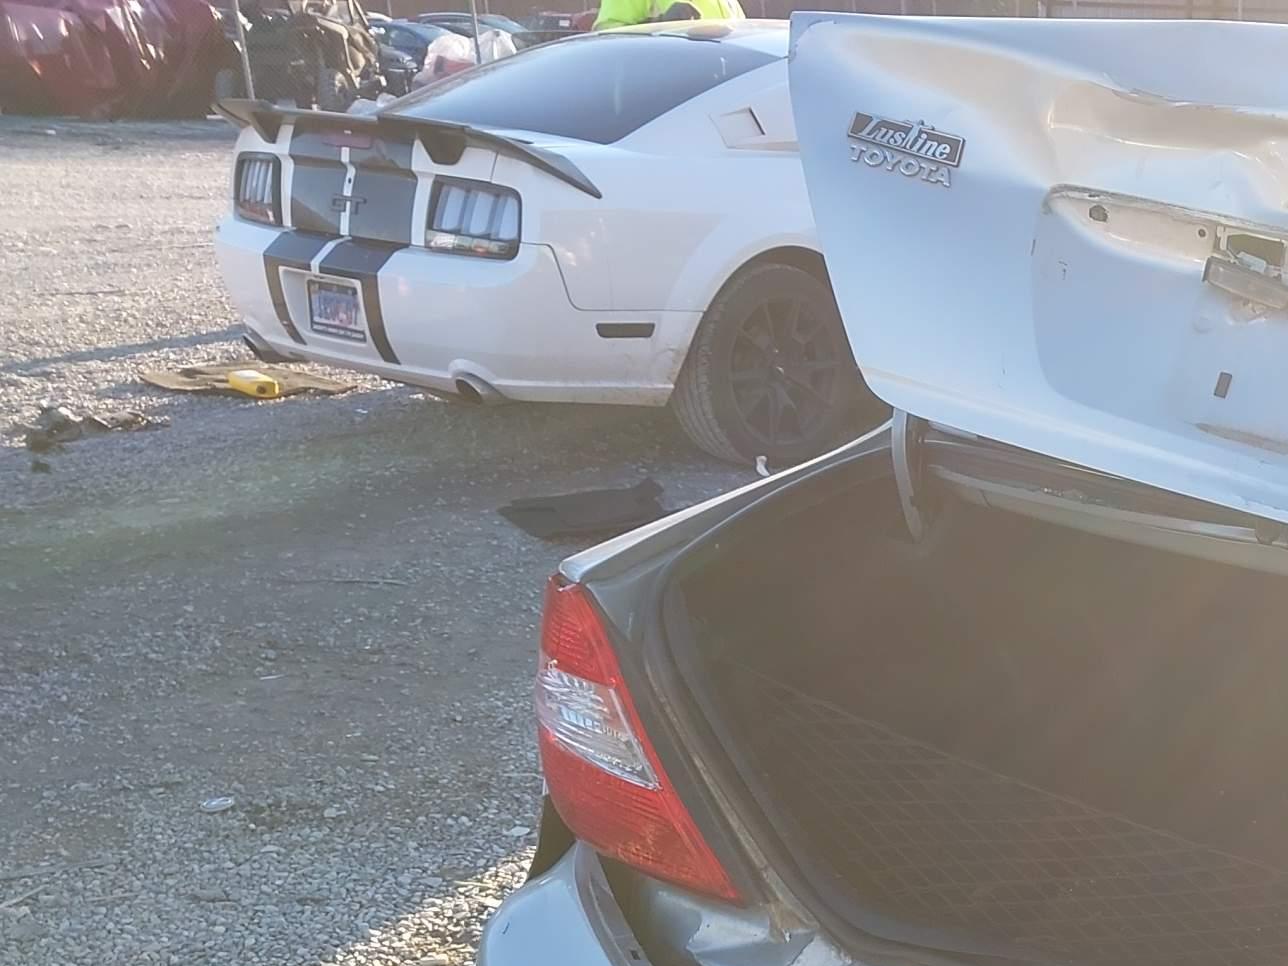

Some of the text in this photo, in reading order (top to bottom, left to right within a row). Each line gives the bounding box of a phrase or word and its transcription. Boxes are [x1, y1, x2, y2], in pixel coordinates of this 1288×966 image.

[858, 114, 952, 161] Lustine
[850, 144, 952, 188] TOYOTA
[331, 193, 367, 216] GT
